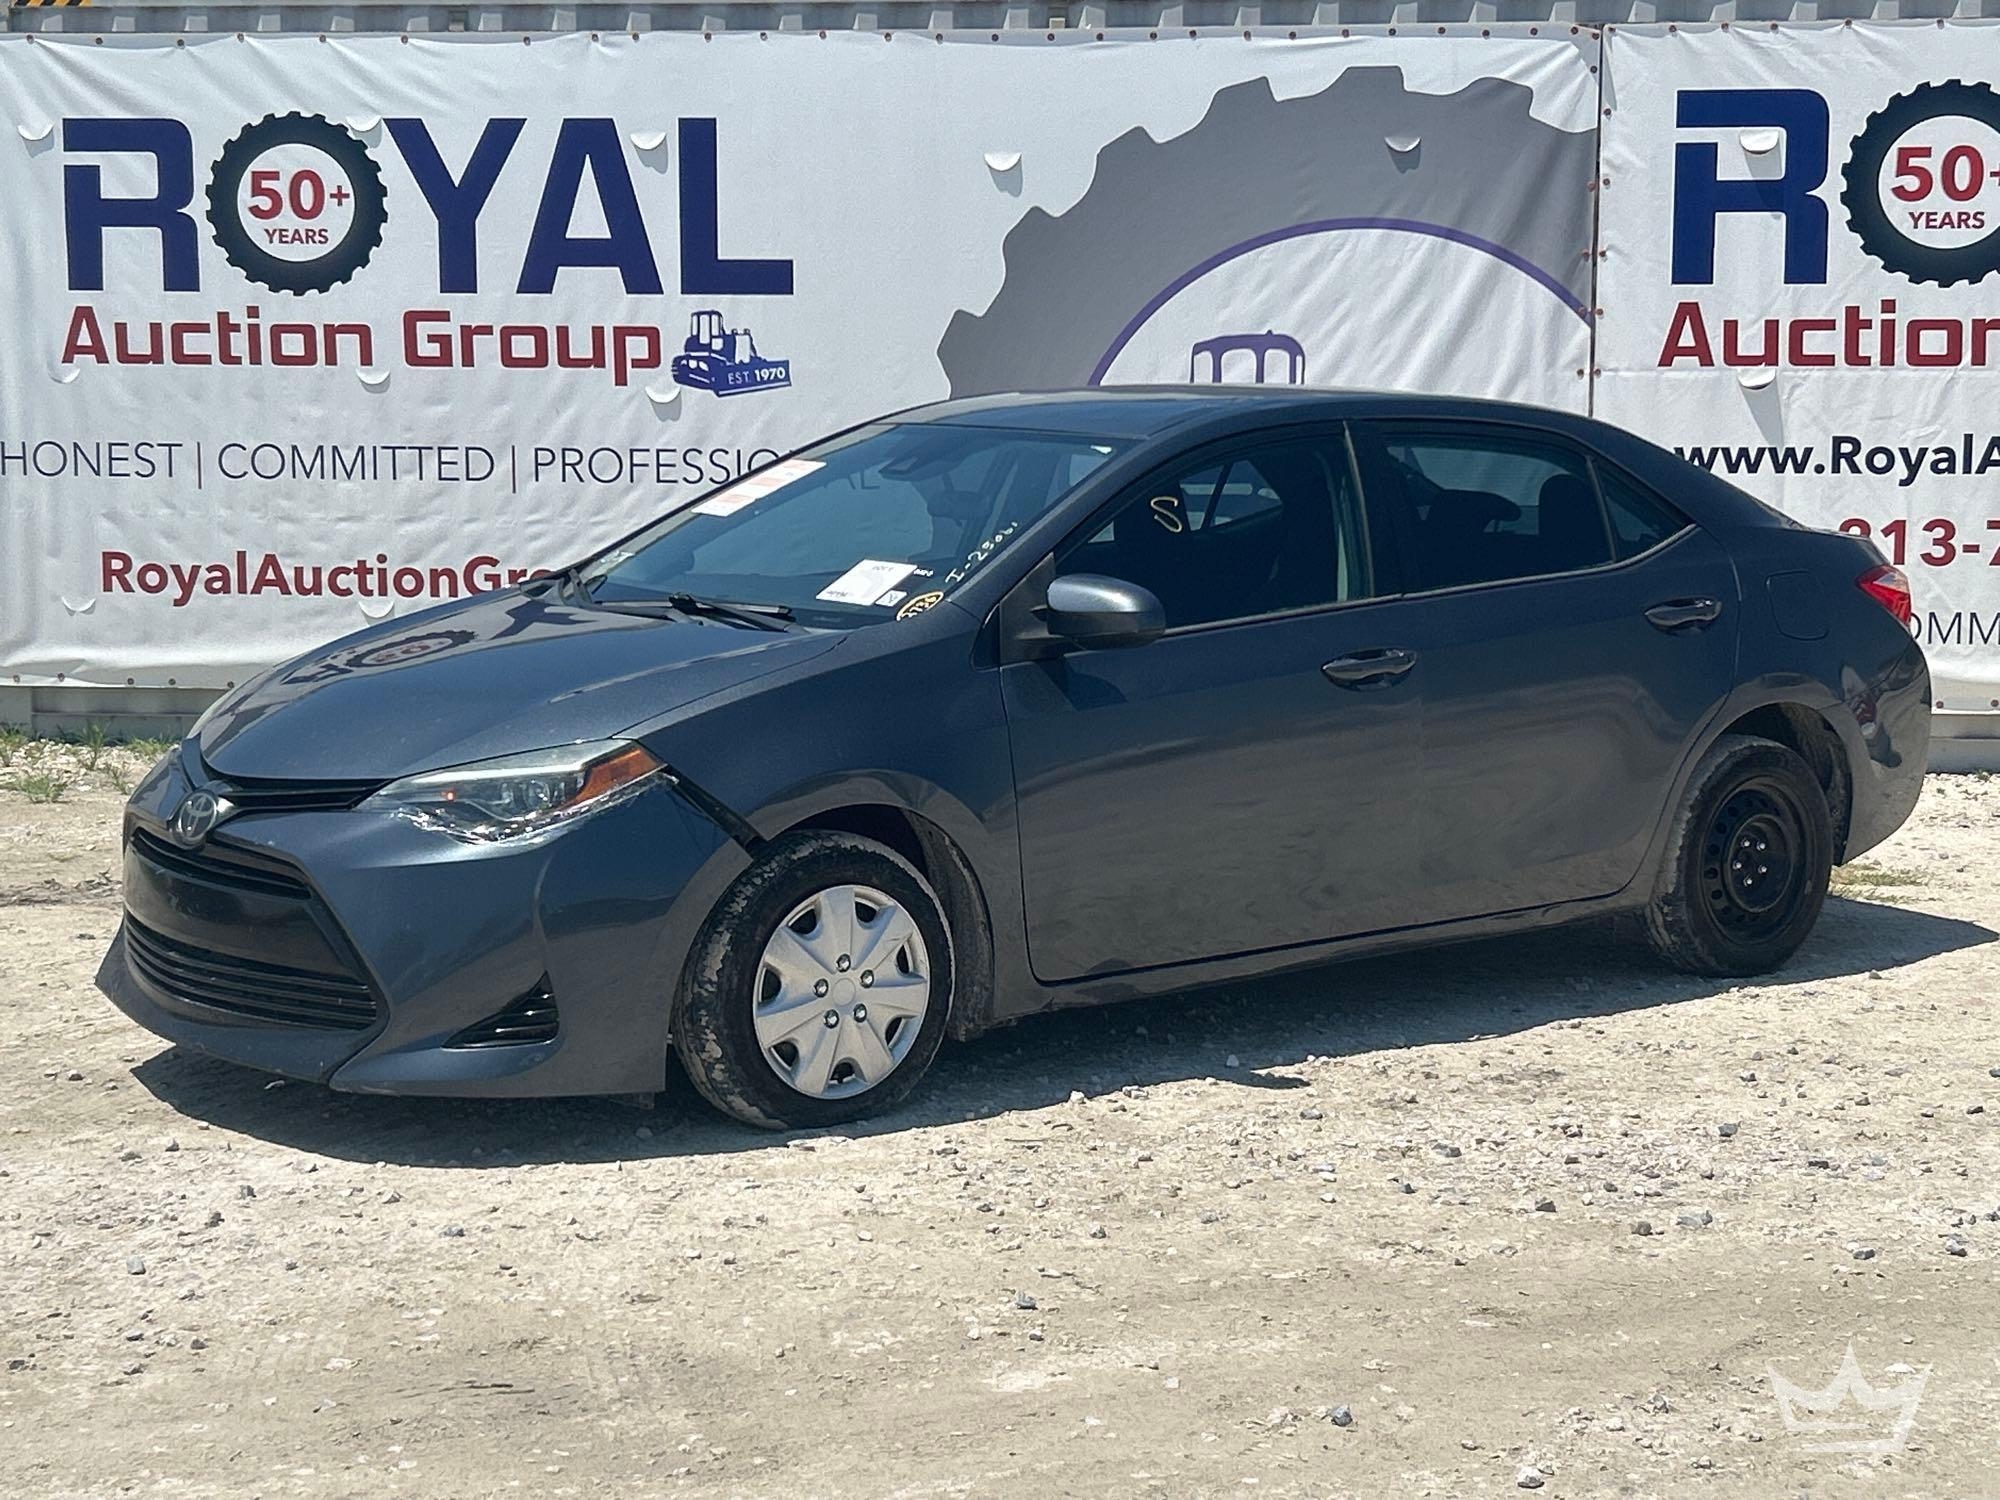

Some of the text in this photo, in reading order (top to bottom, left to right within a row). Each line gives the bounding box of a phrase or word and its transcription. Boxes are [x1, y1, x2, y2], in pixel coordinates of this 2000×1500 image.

[248, 169, 350, 220] 50+
[1908, 211, 1985, 229] YEARS
[264, 228, 329, 244] YEARS
[61, 305, 662, 386] Auction Group
[754, 367, 786, 382] 1970
[0, 441, 183, 478] HONEST
[218, 443, 495, 482] COMMITTED
